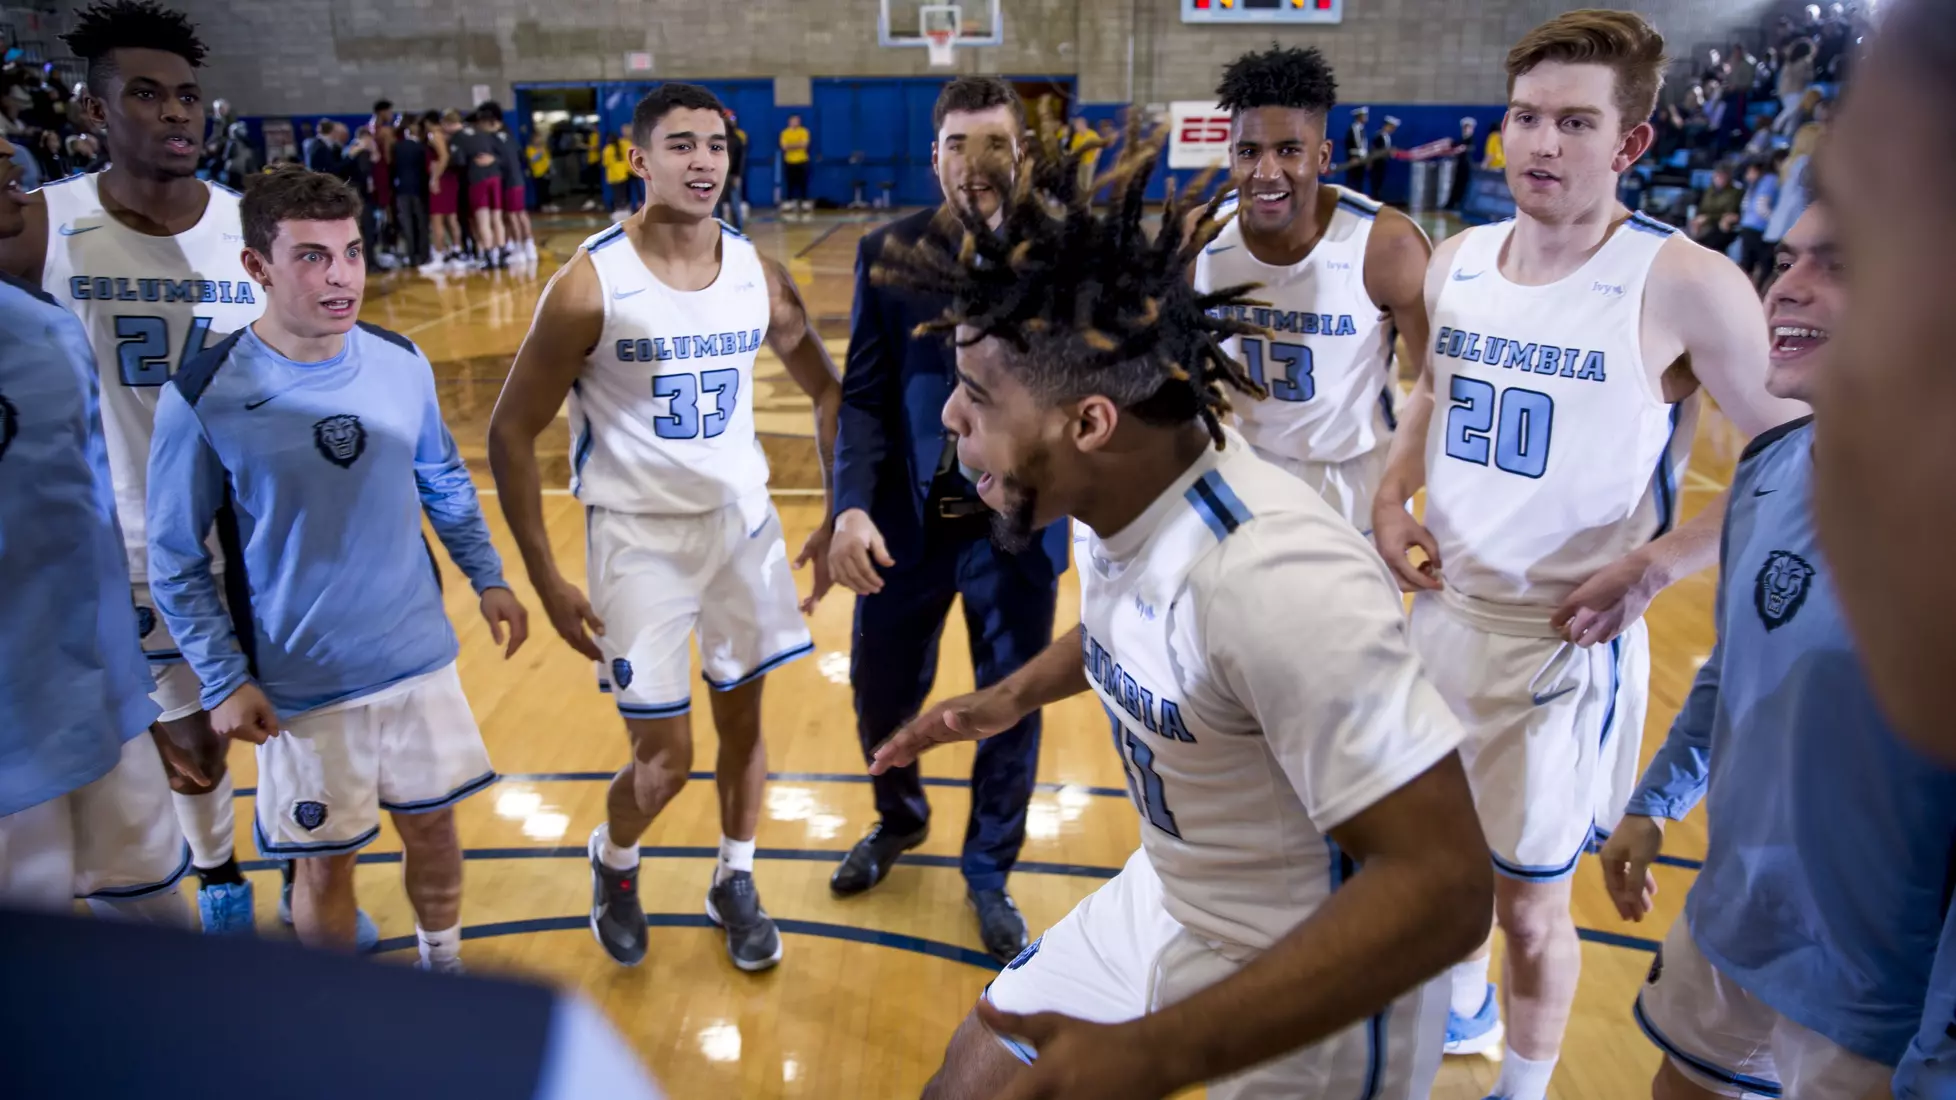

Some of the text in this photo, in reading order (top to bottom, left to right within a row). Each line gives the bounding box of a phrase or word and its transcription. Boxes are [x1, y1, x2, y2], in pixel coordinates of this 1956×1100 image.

[1180, 117, 1232, 142] ES
[69, 275, 255, 304] COLUMBIA
[616, 328, 761, 363] COLUMBIA
[1204, 305, 1357, 336] OLUMBIA
[1241, 337, 1316, 402] 13
[1435, 326, 1606, 382] COLUMBIA
[652, 368, 740, 440] 33
[1446, 374, 1554, 479] 20
[1081, 623, 1198, 744] LUMBIA
